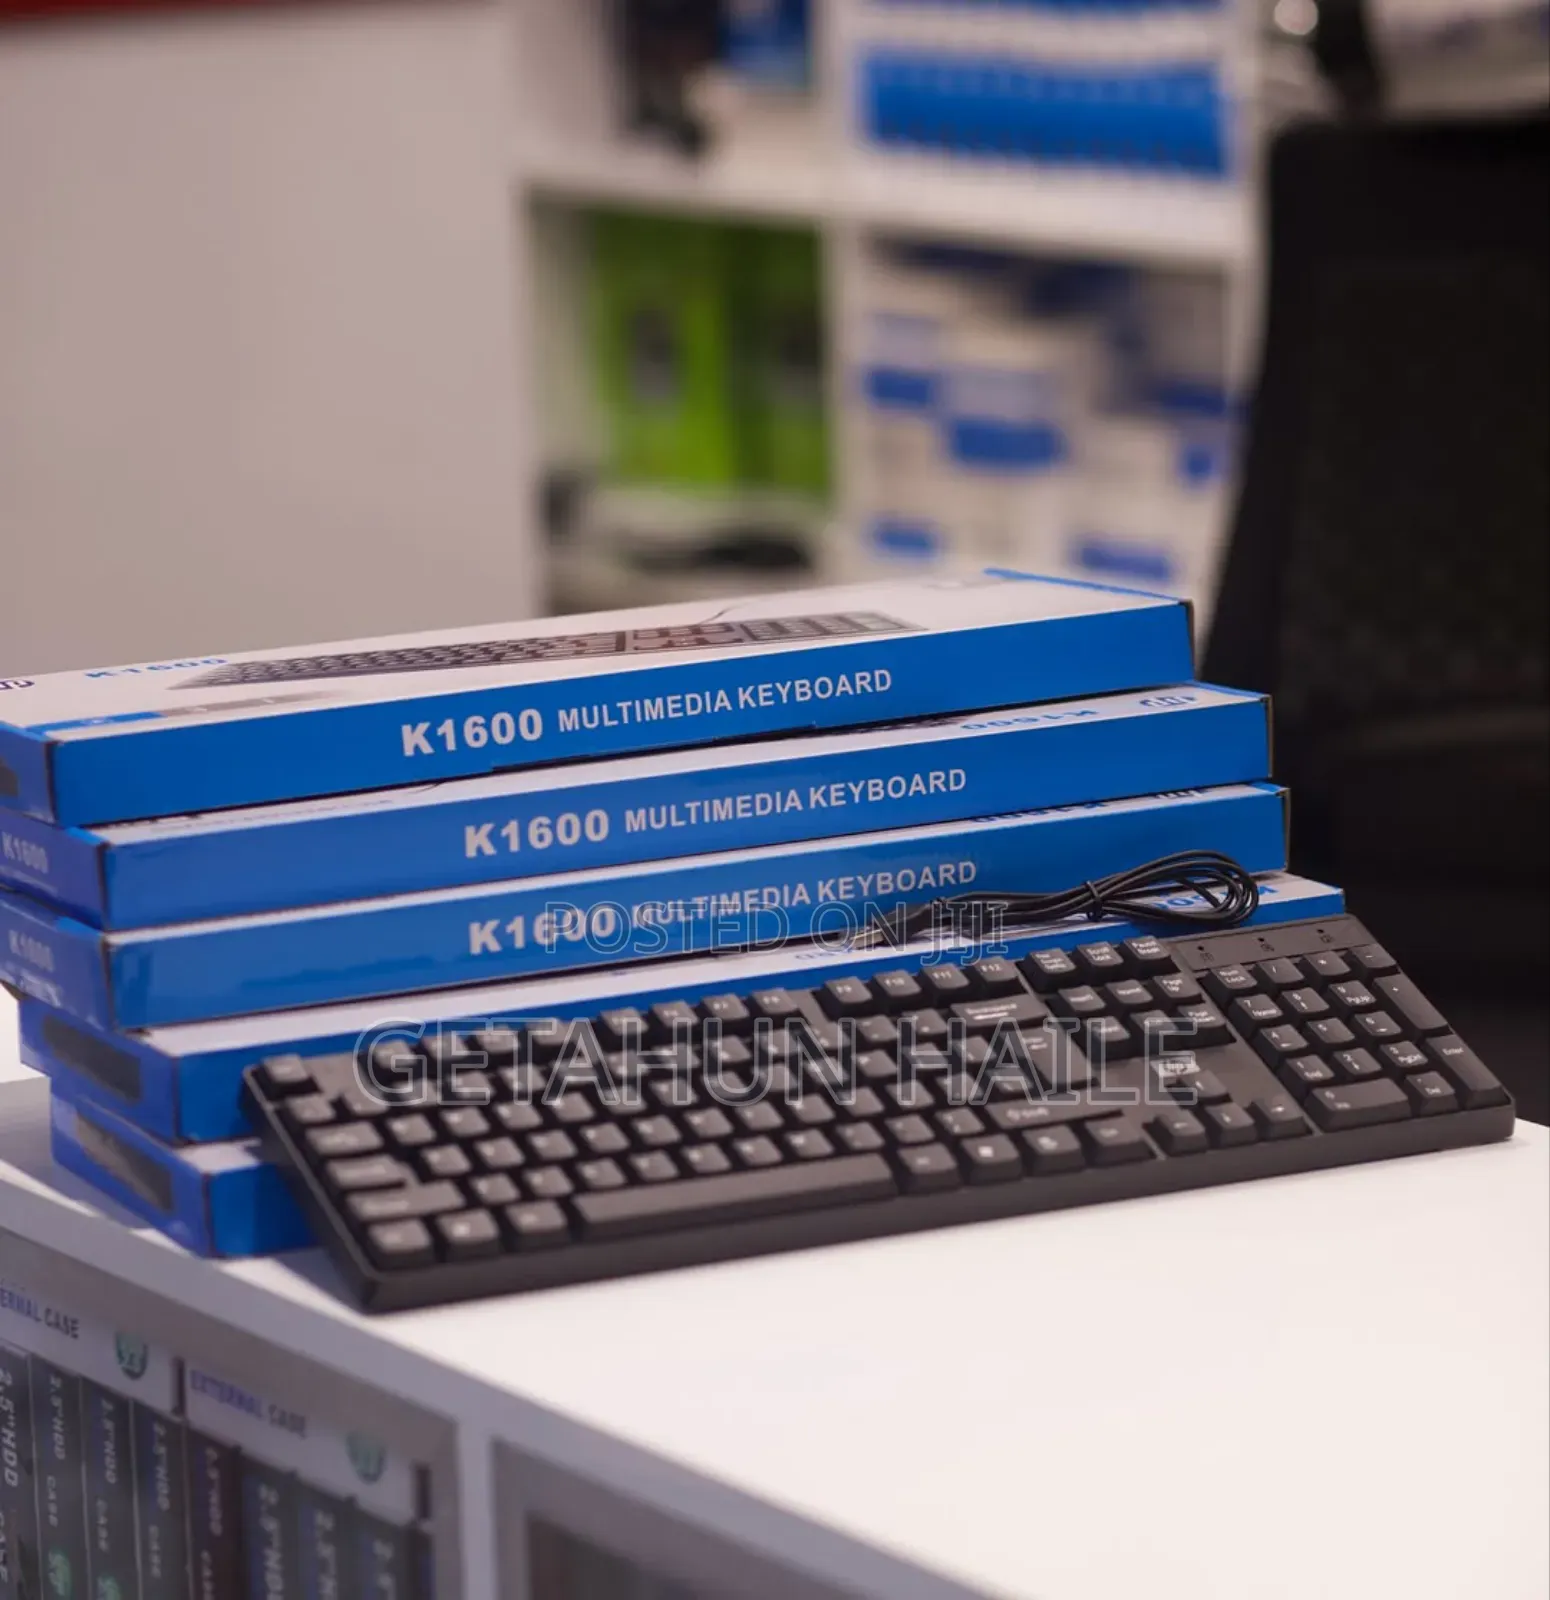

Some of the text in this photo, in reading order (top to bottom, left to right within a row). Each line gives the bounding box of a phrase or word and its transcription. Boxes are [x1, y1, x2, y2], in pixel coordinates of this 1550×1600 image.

[401, 668, 893, 757] K1600 MULTIMEDIA KEYBOARD
[464, 767, 967, 859] K1600 MULTIMEDIA KEYBOARD
[468, 861, 977, 955] K1600 MULTIMEDIA KEYBOARD
[44, 1306, 80, 1340] CASE
